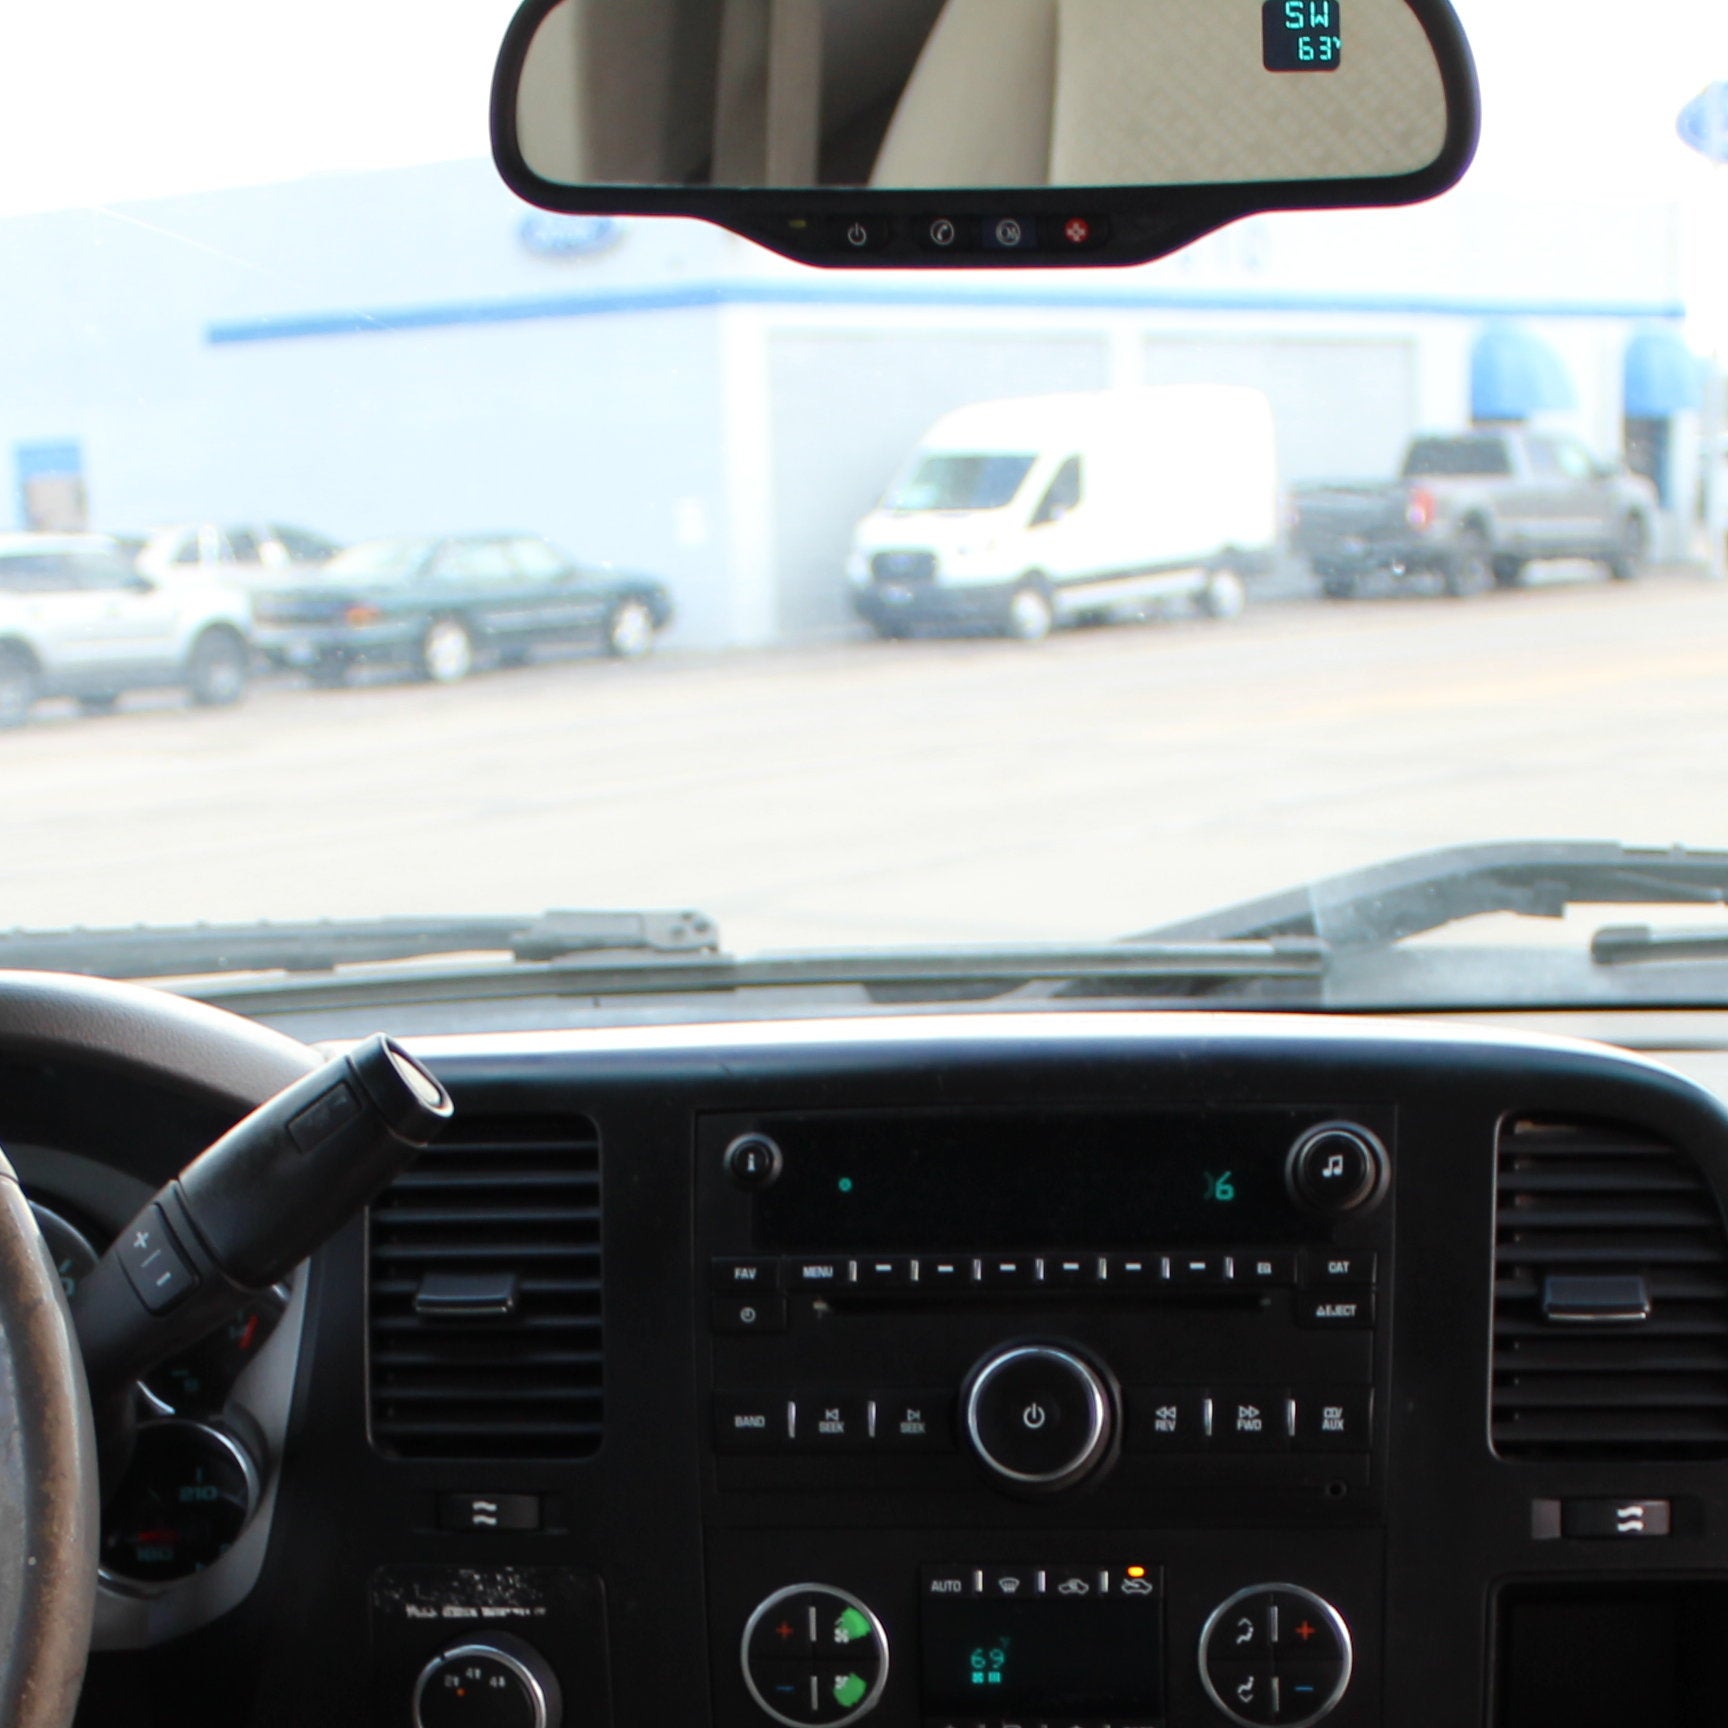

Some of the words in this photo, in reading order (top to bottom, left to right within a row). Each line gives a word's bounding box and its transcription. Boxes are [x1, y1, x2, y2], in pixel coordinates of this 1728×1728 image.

[1284, 0, 1330, 29] SW
[734, 1266, 757, 1280] FAV
[802, 1265, 834, 1279] MENU
[1327, 1261, 1350, 1274] CAT
[734, 1415, 766, 1428] BAND
[818, 1421, 844, 1433] SEEK
[1155, 1419, 1176, 1432] REV
[1236, 1419, 1262, 1431] FWD
[1322, 1419, 1344, 1431] AUX
[930, 1579, 962, 1593] AUTO
